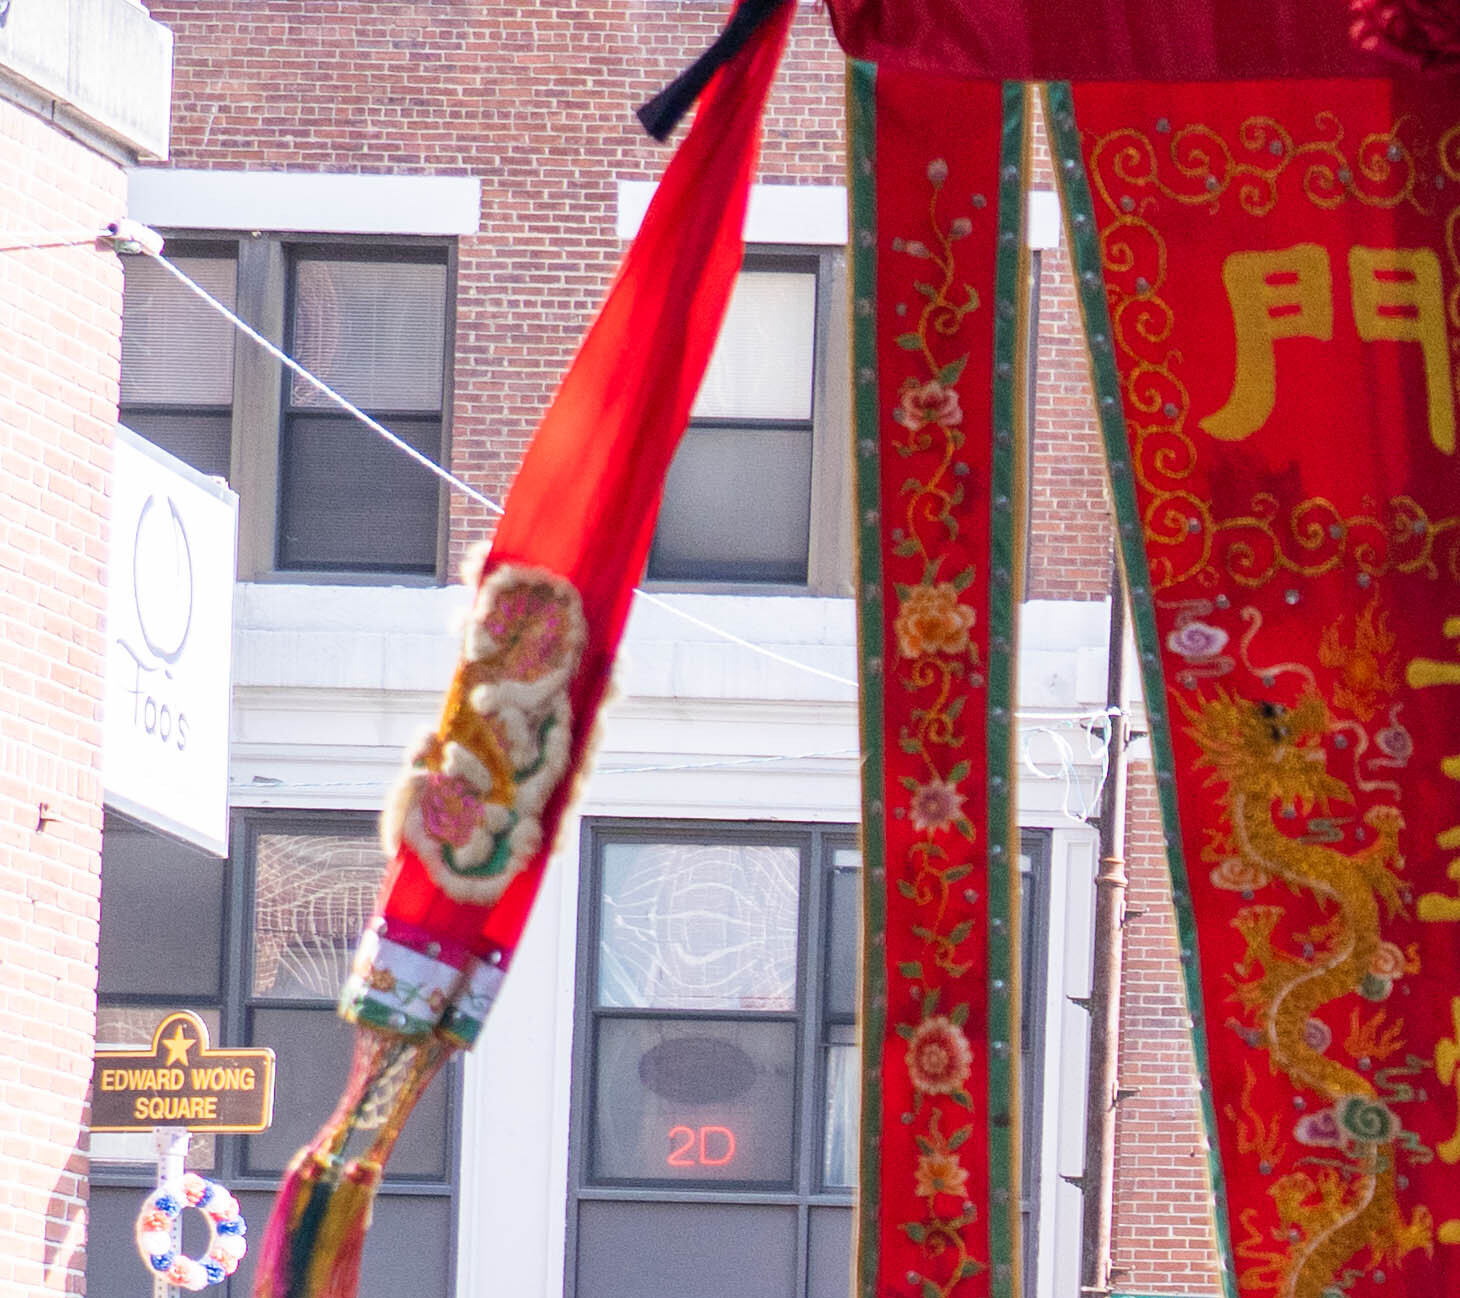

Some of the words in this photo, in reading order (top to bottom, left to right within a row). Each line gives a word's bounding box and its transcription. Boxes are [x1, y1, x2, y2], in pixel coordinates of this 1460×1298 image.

[101, 1068, 185, 1092] EDWARD
[191, 1066, 256, 1091] WONG
[134, 1097, 218, 1120] SQUARE
[666, 1125, 737, 1167] 2D
